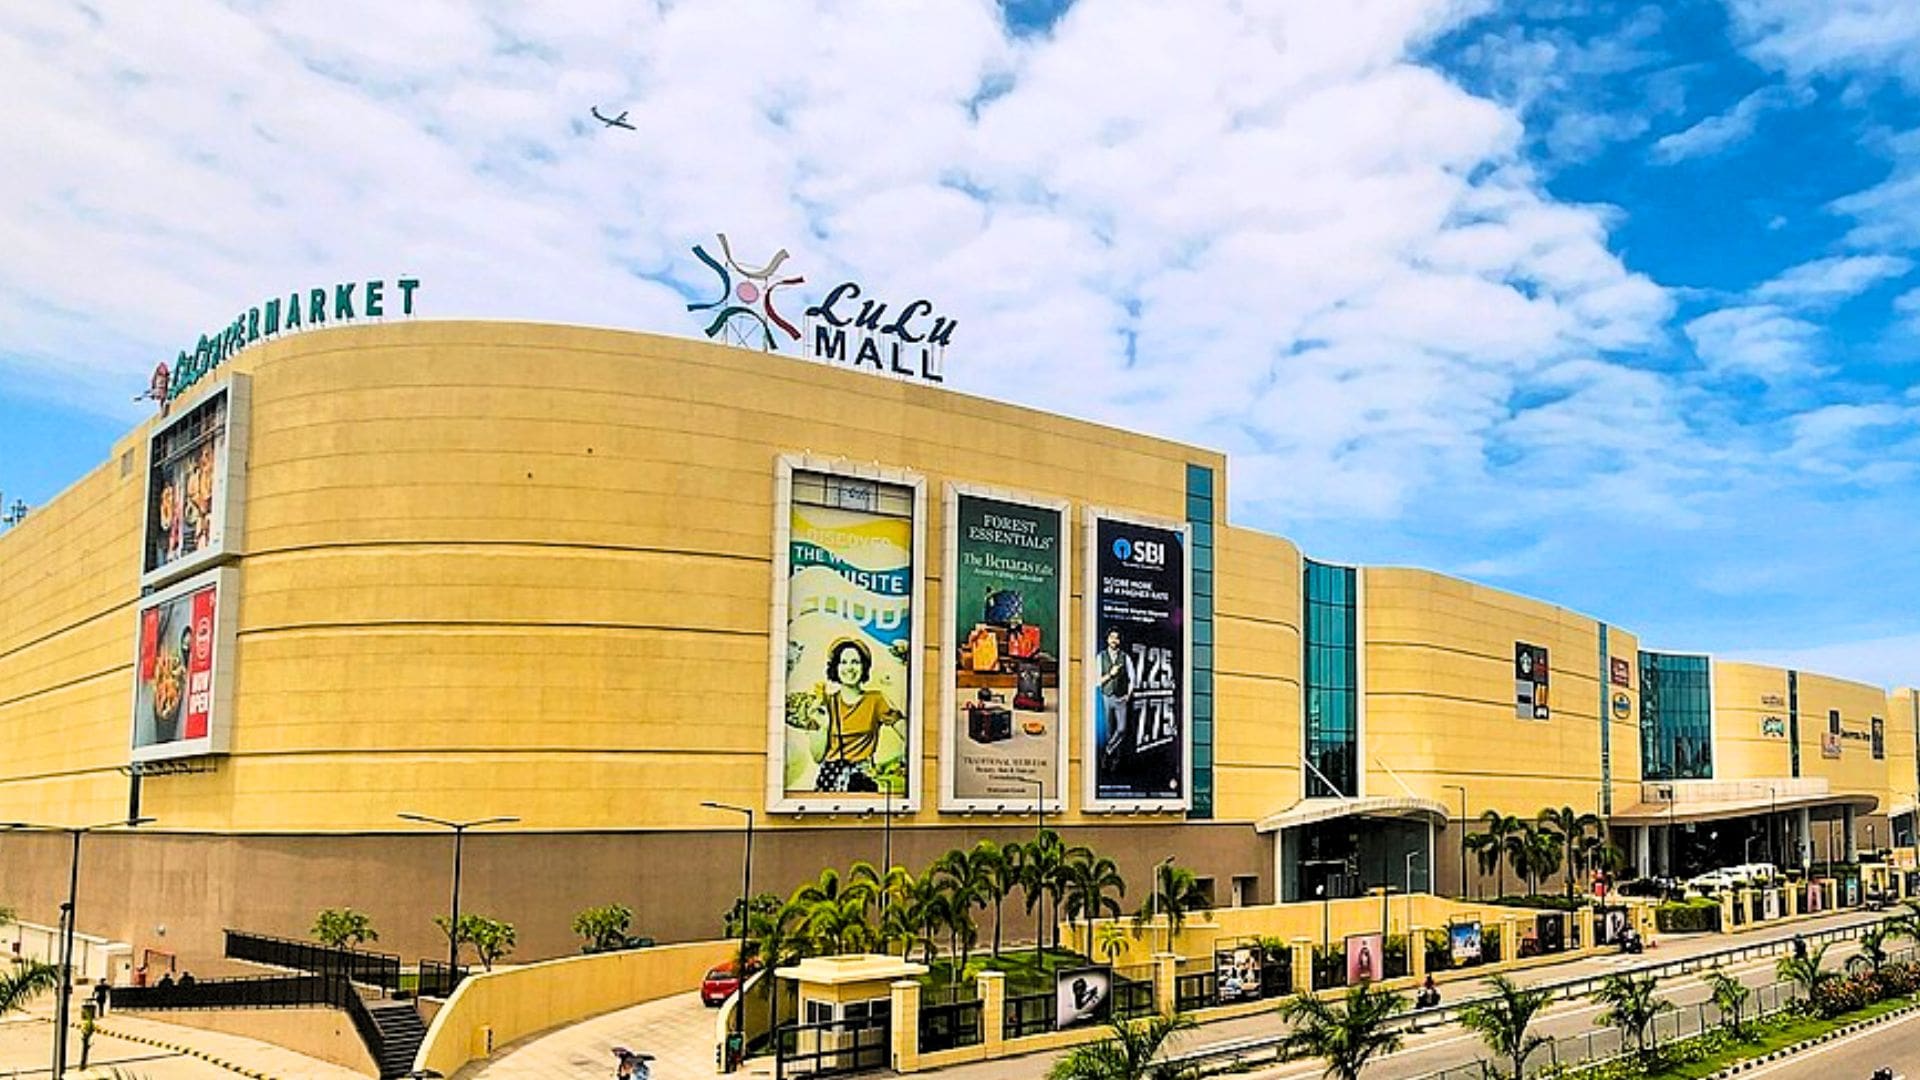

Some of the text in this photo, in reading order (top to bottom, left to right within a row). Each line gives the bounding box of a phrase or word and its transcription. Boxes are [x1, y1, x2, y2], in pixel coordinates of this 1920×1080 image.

[805, 282, 958, 346] LuLu
[815, 325, 943, 383] MALL
[983, 514, 1037, 535] FOREST
[794, 545, 825, 562] THE
[963, 553, 983, 567] The
[1133, 541, 1165, 566] SBI
